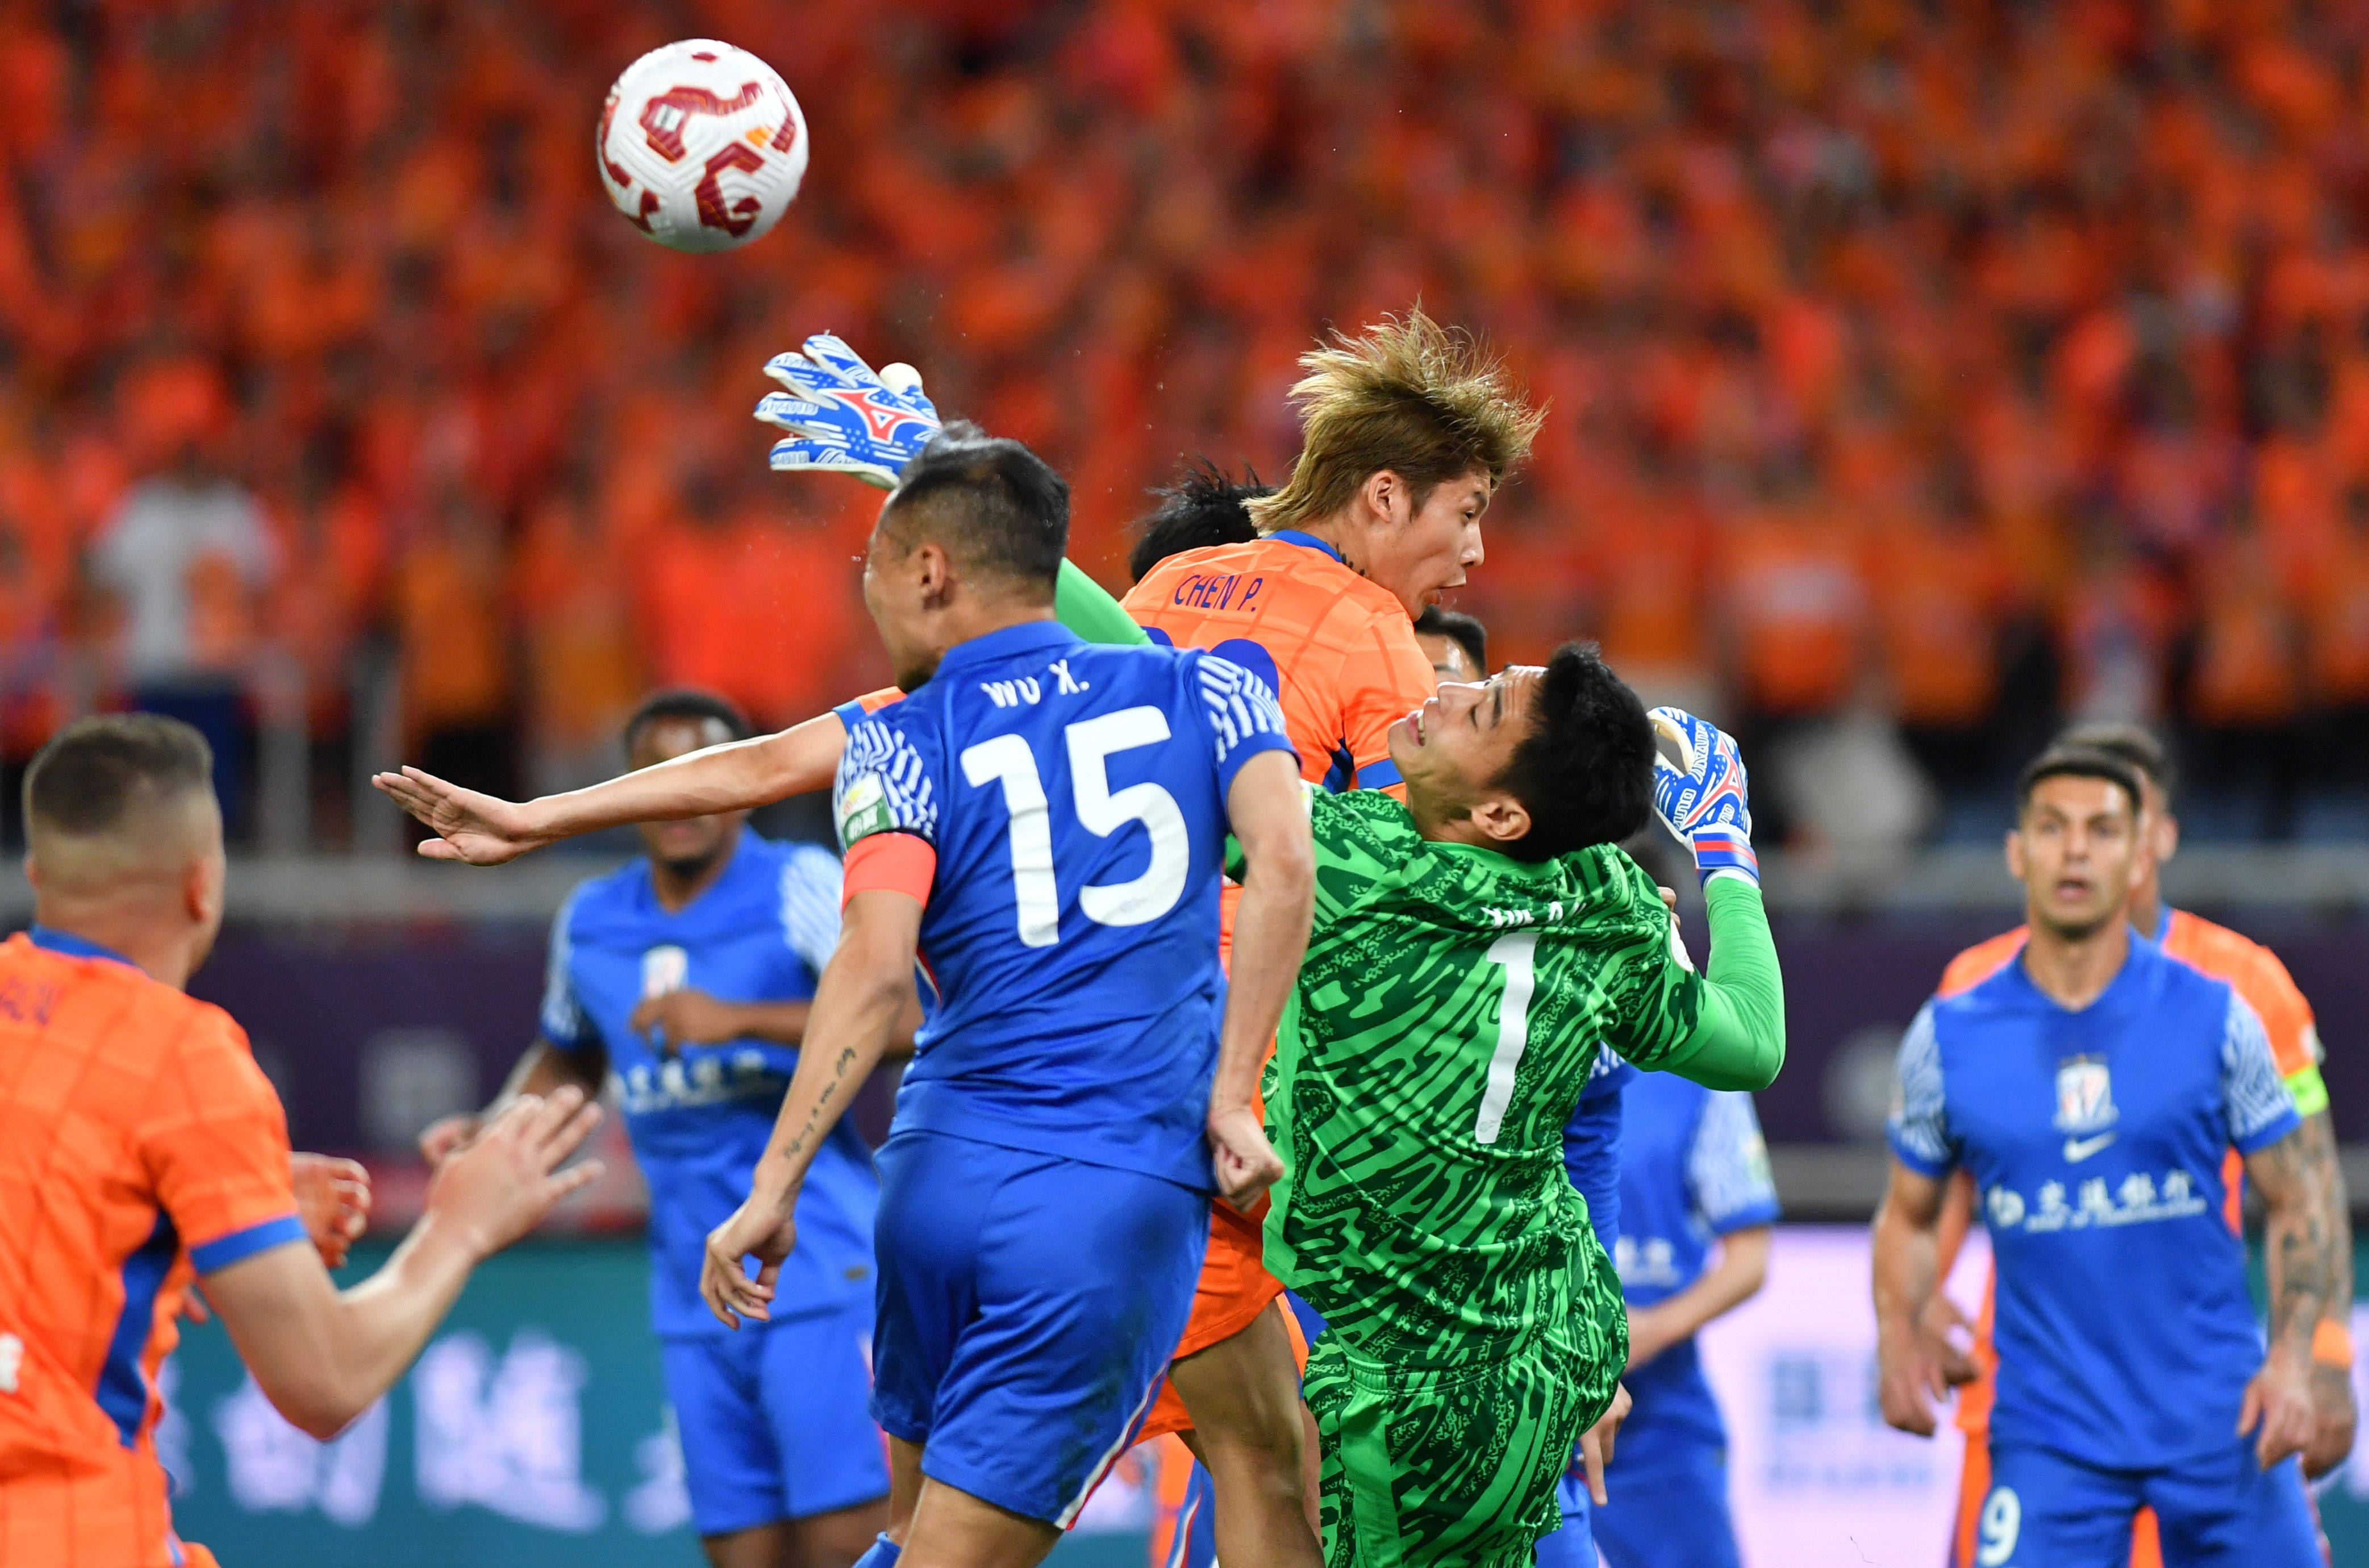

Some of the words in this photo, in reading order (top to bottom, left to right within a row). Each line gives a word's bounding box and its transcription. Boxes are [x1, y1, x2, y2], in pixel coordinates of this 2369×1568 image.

[1174, 574, 1242, 610] CHEN
[1237, 577, 1263, 612] P.
[979, 676, 1041, 708] WU
[1048, 659, 1090, 695] X.
[960, 705, 1190, 947] 15
[1475, 932, 1541, 1143] 1
[1978, 1485, 2021, 1566] 9
